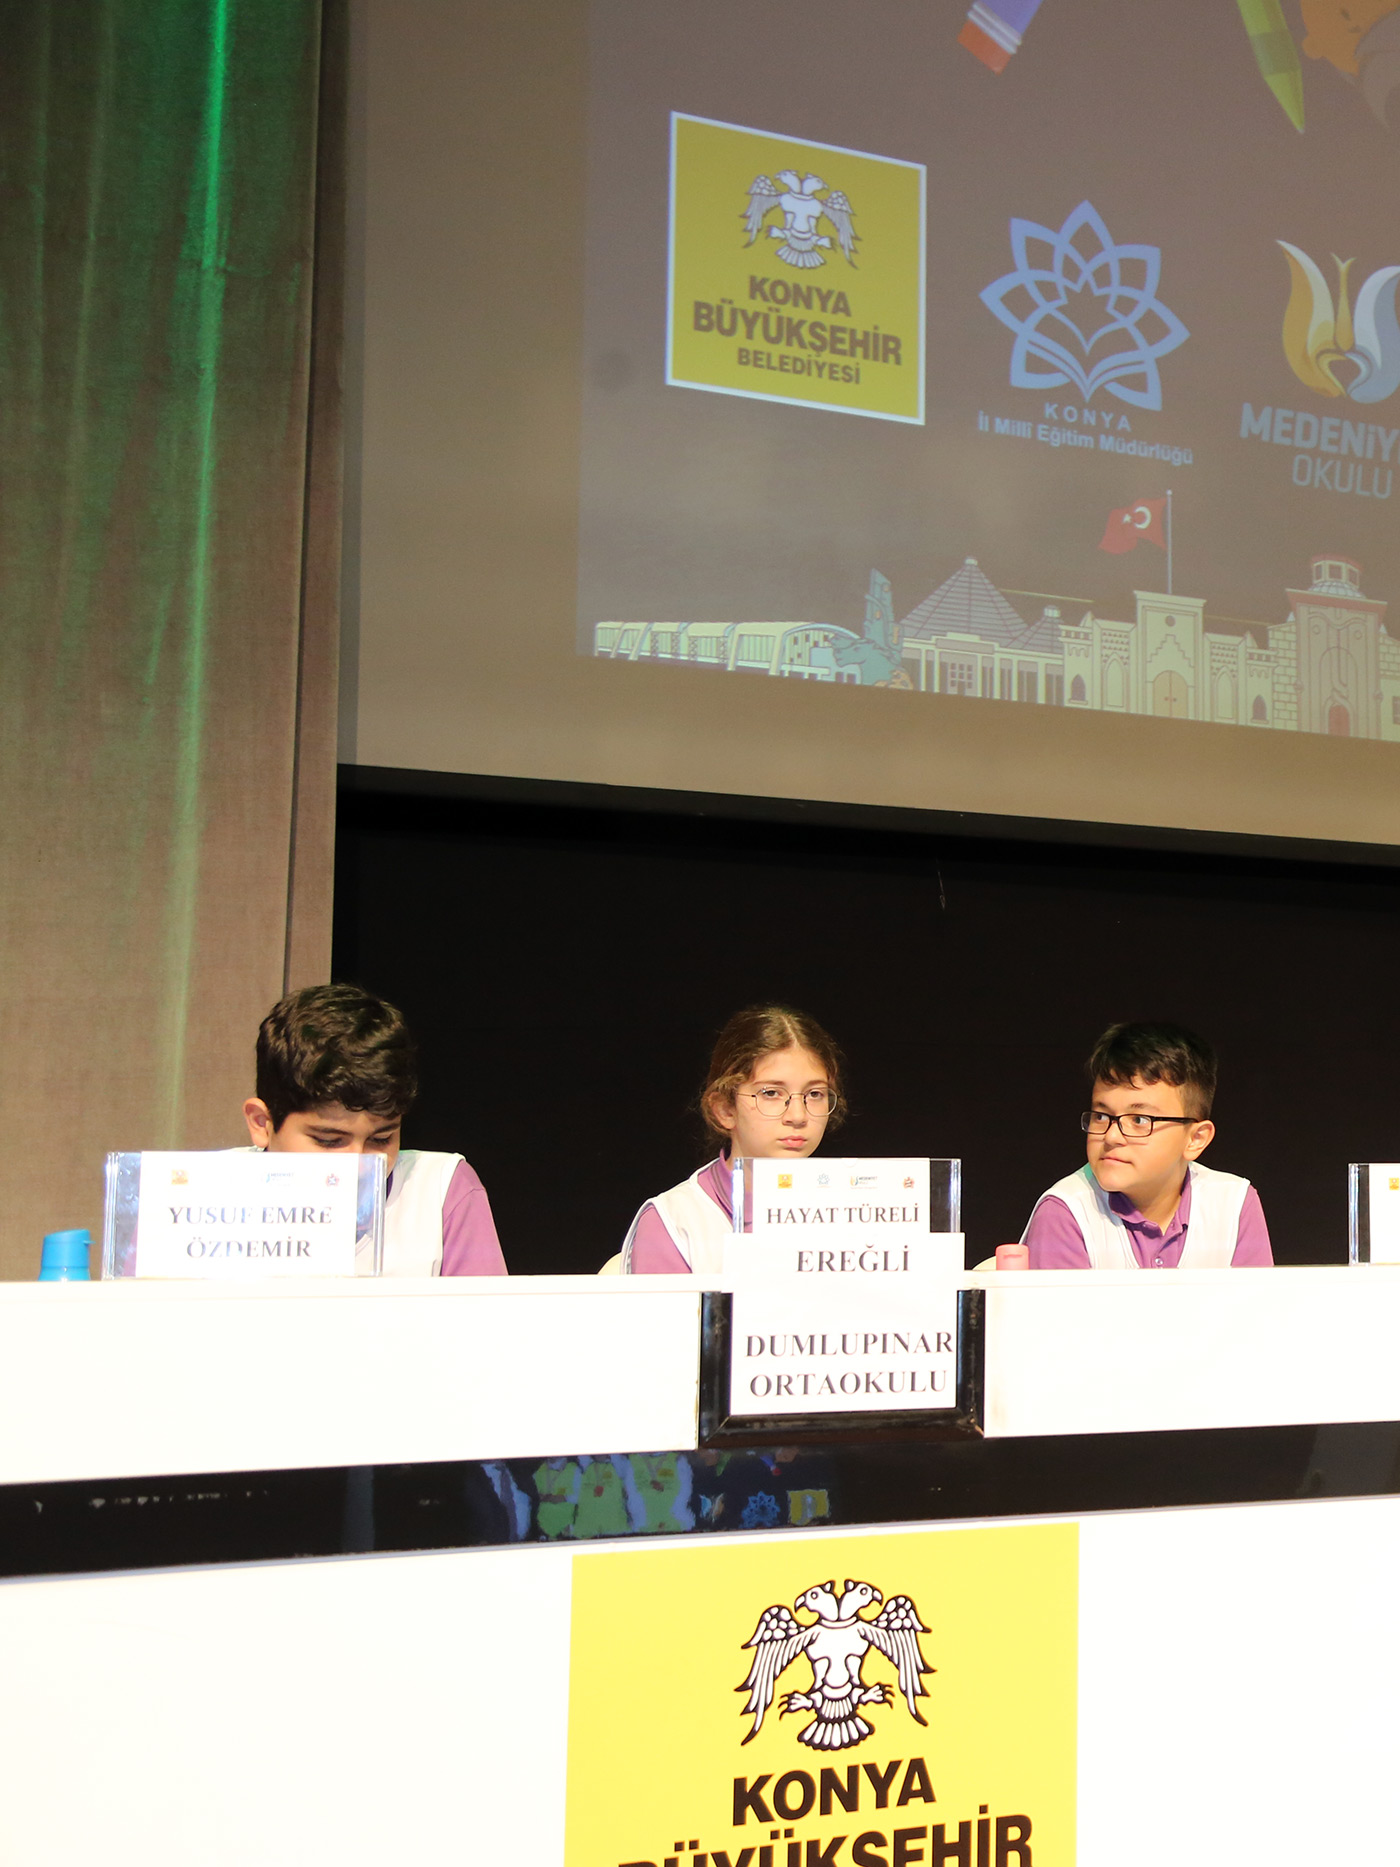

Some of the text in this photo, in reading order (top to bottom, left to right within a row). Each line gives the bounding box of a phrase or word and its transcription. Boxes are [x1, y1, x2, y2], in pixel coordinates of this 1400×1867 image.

[749, 275, 851, 317] KONYA
[693, 298, 902, 366] BÜYÜKŞEHİR
[737, 347, 860, 384] BELEDİYESİ
[1044, 402, 1132, 432] KONYA
[1036, 423, 1094, 447] Eğitim
[1099, 434, 1194, 466] Müdürlüğü
[1292, 454, 1392, 499] OKULU
[261, 1206, 332, 1225] EMRE
[766, 1203, 920, 1225] HAYAT TÜRELİ
[186, 1236, 312, 1258] ÖZDEMİR
[796, 1244, 911, 1273] EREĞLİ
[745, 1331, 954, 1358] DUMLUPINAR
[749, 1370, 947, 1398] ORTAOKULU
[732, 1757, 937, 1827] KONYA
